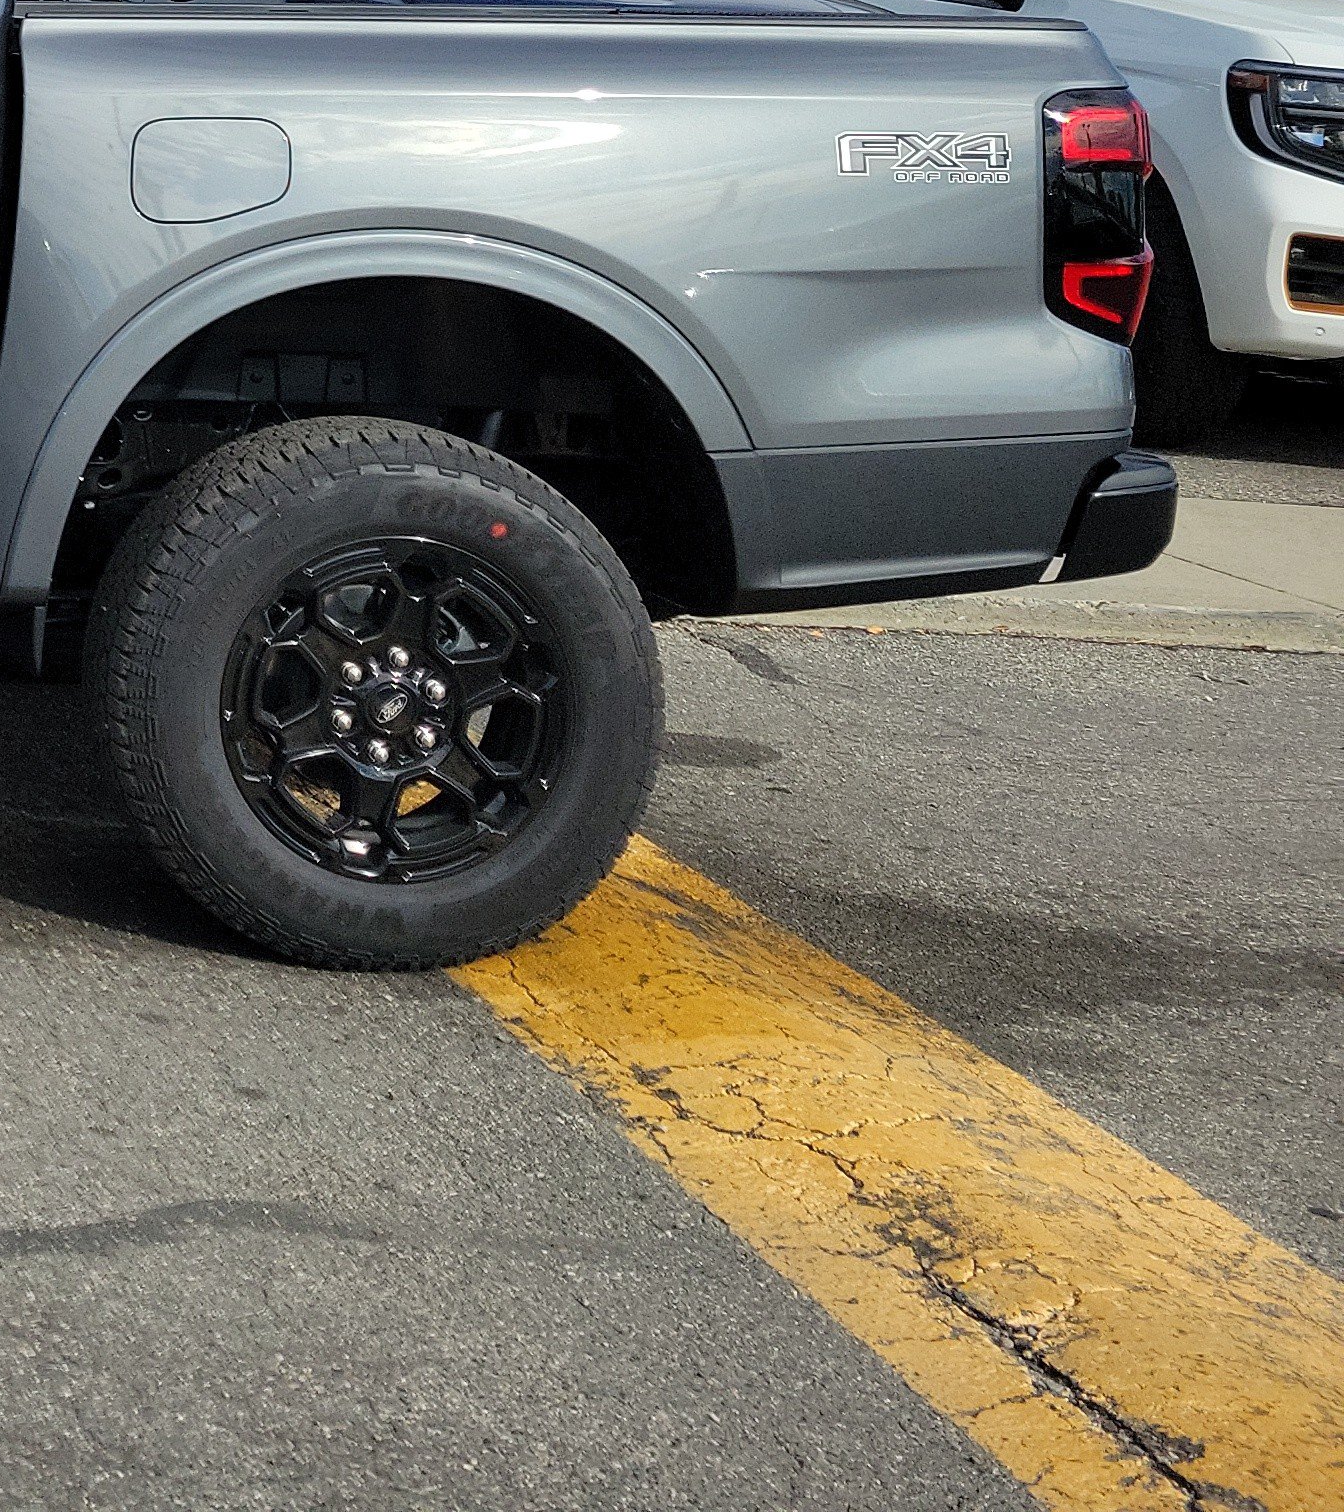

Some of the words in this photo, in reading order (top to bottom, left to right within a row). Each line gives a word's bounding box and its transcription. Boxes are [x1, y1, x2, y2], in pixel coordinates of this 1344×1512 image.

[834, 131, 1012, 176] FX4
[894, 171, 941, 183] OFF
[948, 171, 1011, 184] ROAD
